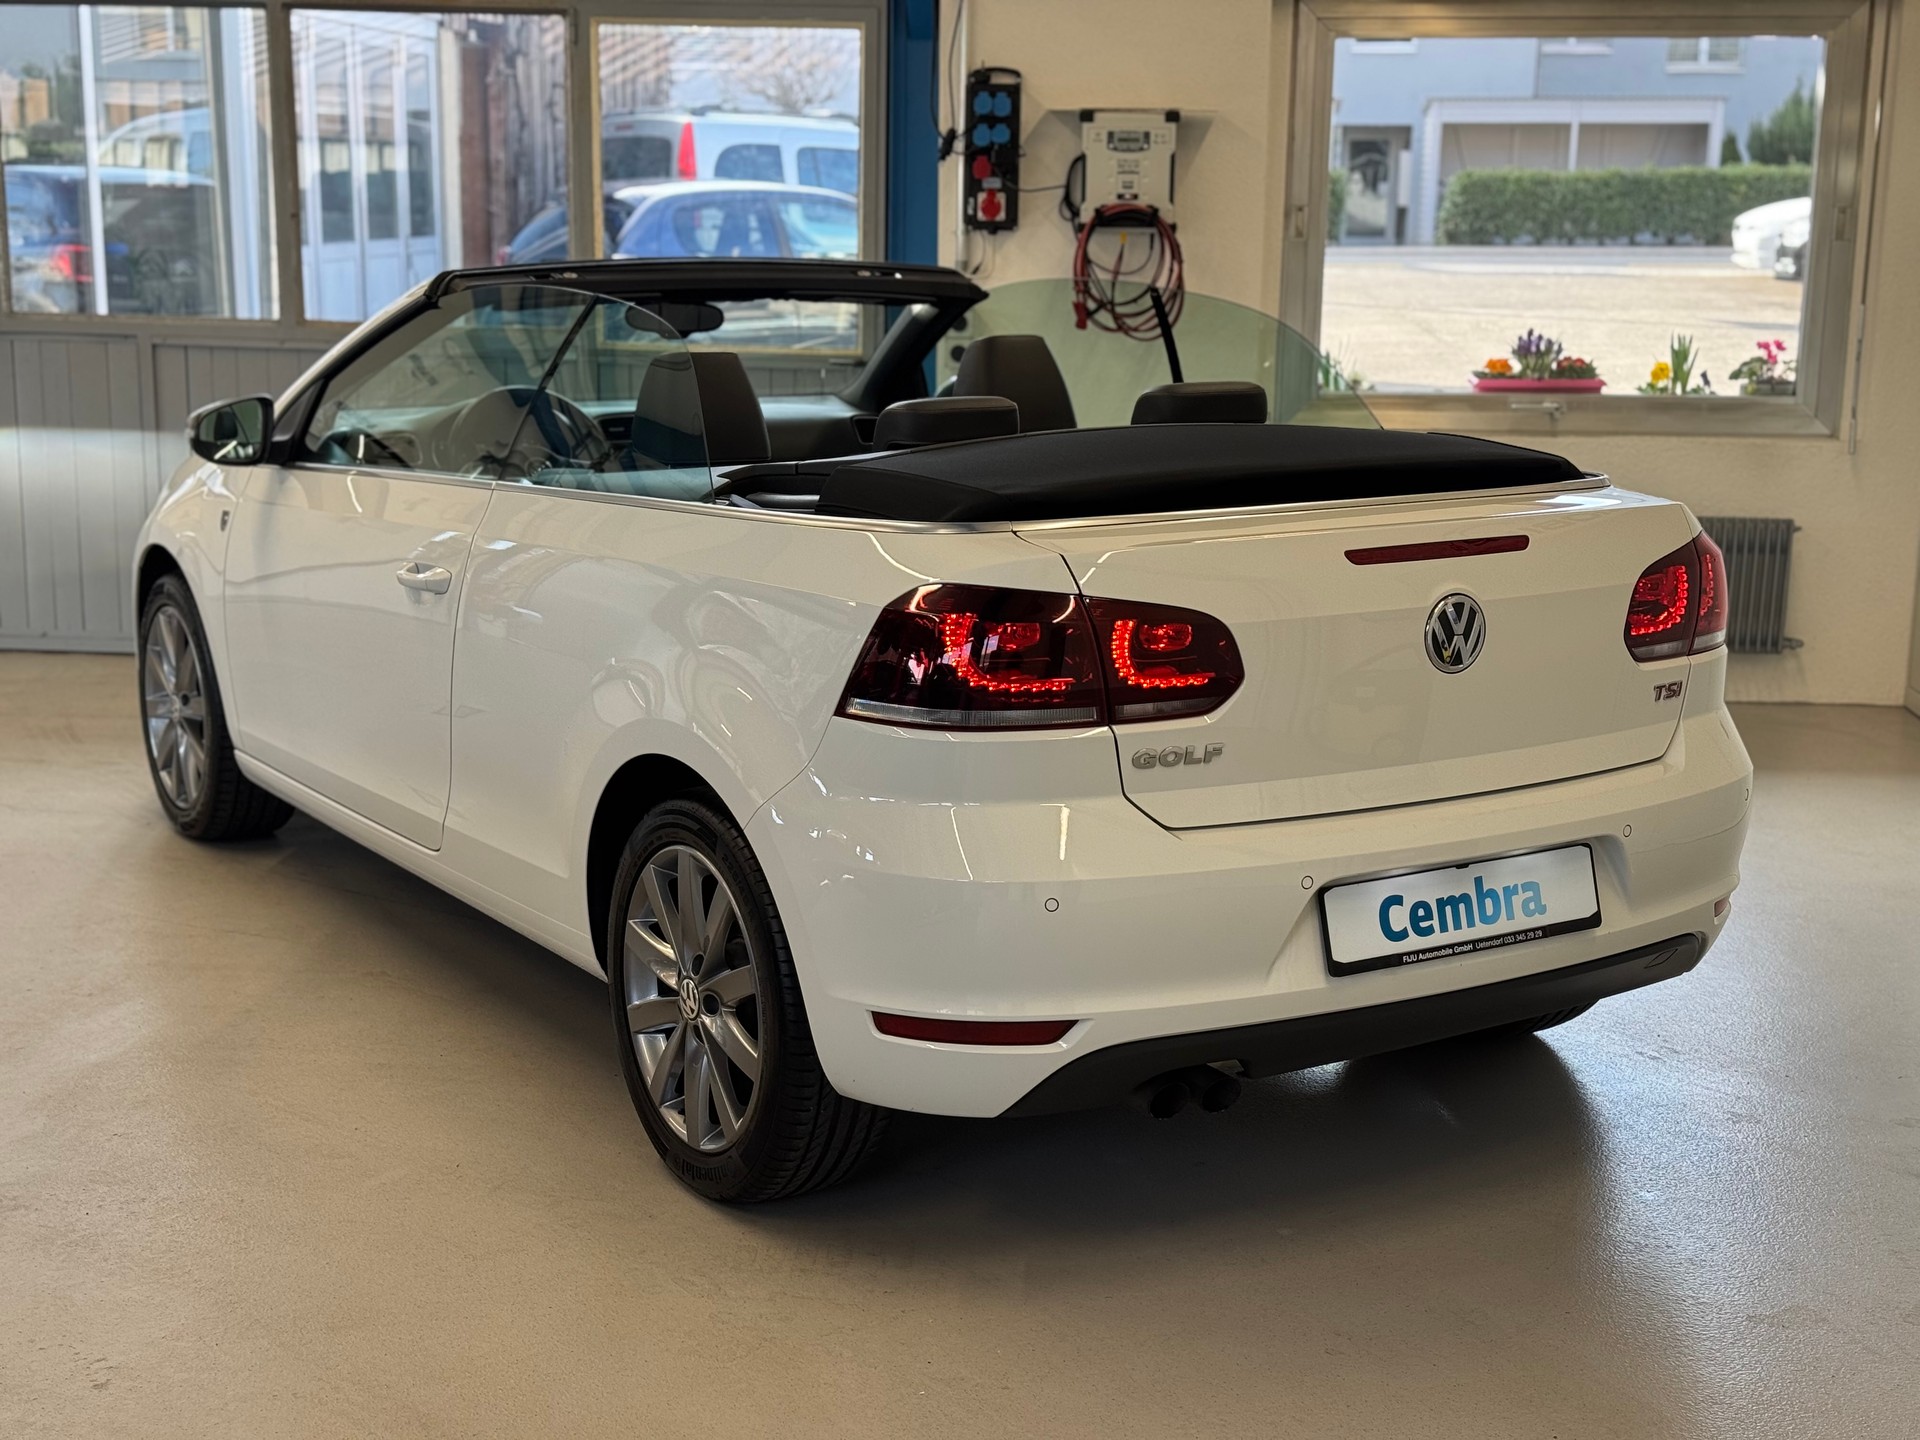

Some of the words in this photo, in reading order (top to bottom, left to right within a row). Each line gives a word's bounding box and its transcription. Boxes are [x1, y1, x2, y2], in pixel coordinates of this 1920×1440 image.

[1653, 680, 1683, 702] TSI
[1131, 742, 1225, 769] GOLF
[1378, 875, 1548, 942] Cembra
[1402, 955, 1418, 963] FIJU
[1418, 948, 1453, 960] Automobile
[1453, 943, 1474, 954] GmbH
[1475, 937, 1503, 949] Uetendorf
[1503, 936, 1515, 944] 033
[1515, 933, 1526, 942] 345
[1527, 931, 1535, 940] 29
[1535, 930, 1543, 938] 29
